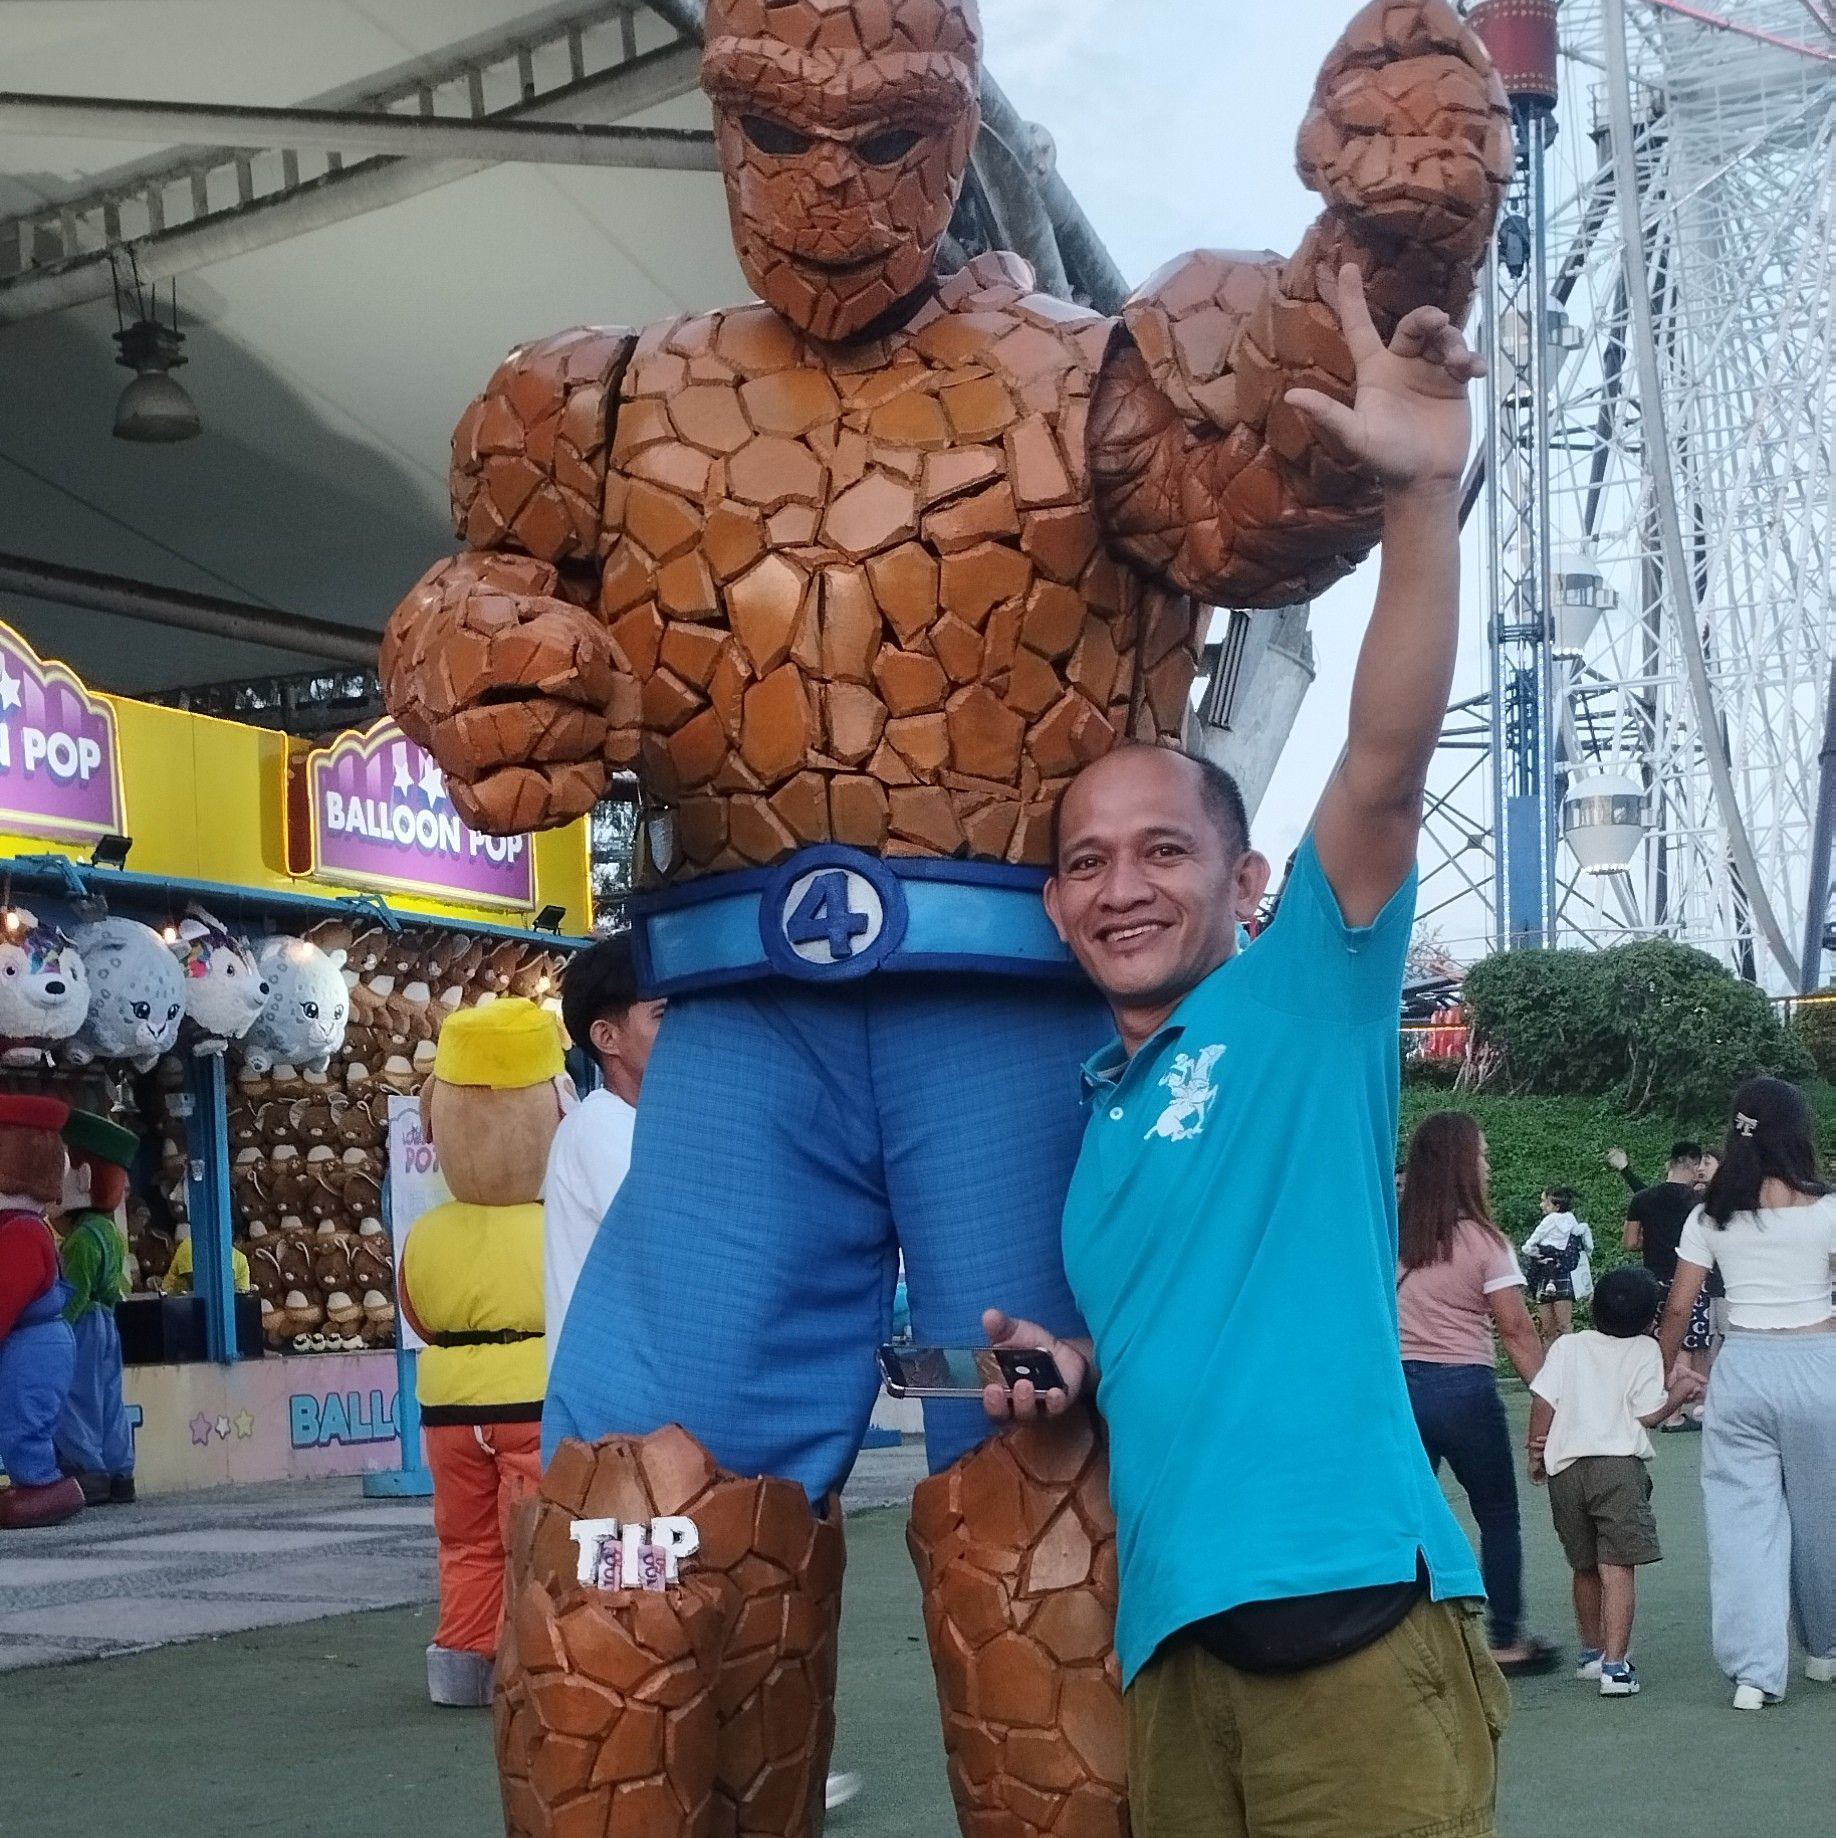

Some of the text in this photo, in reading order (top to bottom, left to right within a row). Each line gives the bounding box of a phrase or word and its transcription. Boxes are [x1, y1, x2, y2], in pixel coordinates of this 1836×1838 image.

[22, 726, 101, 780] POP
[326, 790, 461, 854] BALLOON
[786, 871, 869, 960] 4
[569, 1516, 700, 1588] TIP
